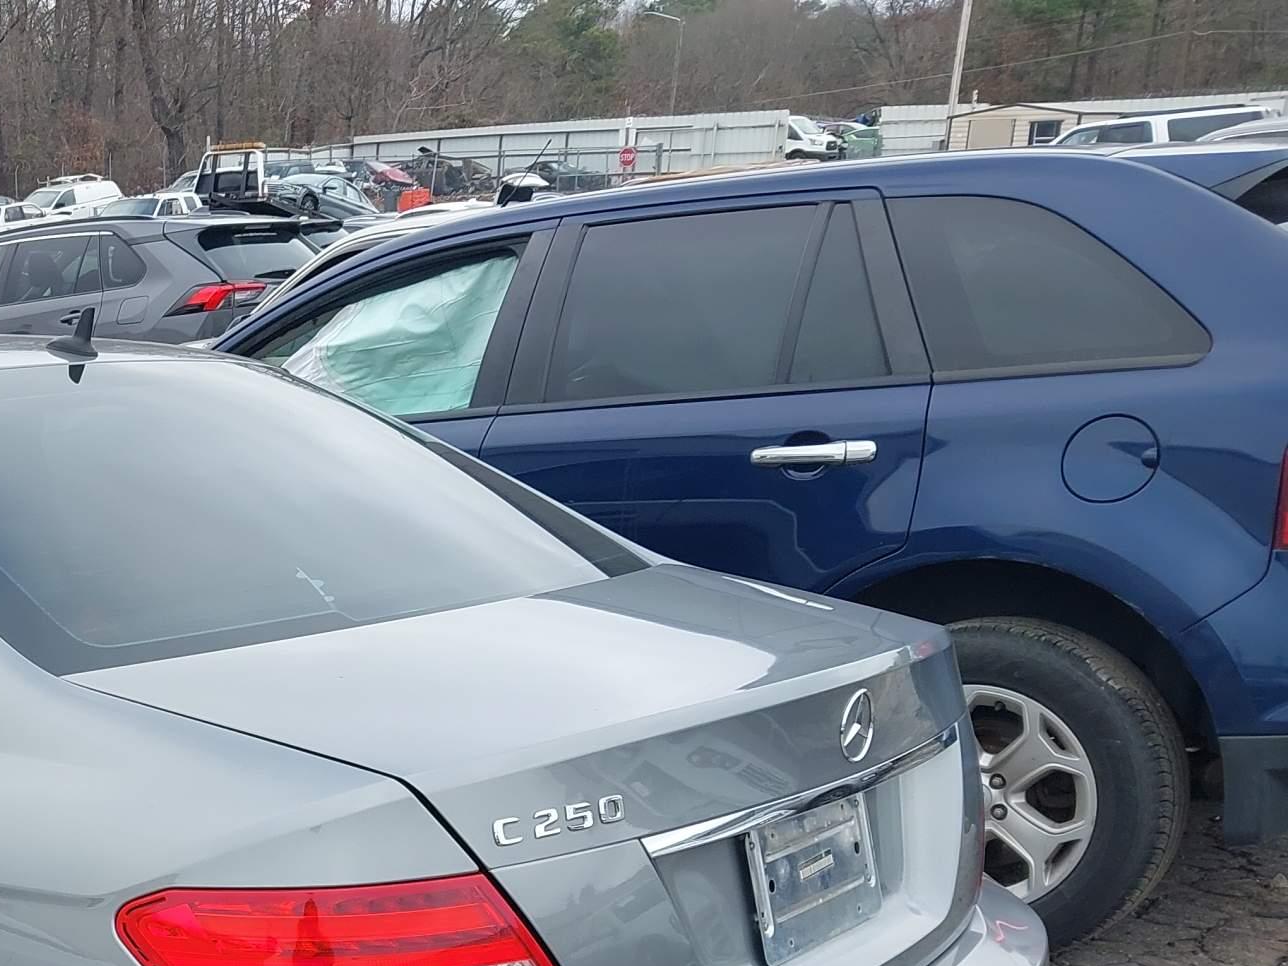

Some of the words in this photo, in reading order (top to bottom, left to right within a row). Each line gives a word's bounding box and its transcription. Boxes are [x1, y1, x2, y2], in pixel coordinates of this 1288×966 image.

[621, 153, 635, 161] STOP
[492, 816, 524, 847] C
[533, 794, 626, 840] 250
